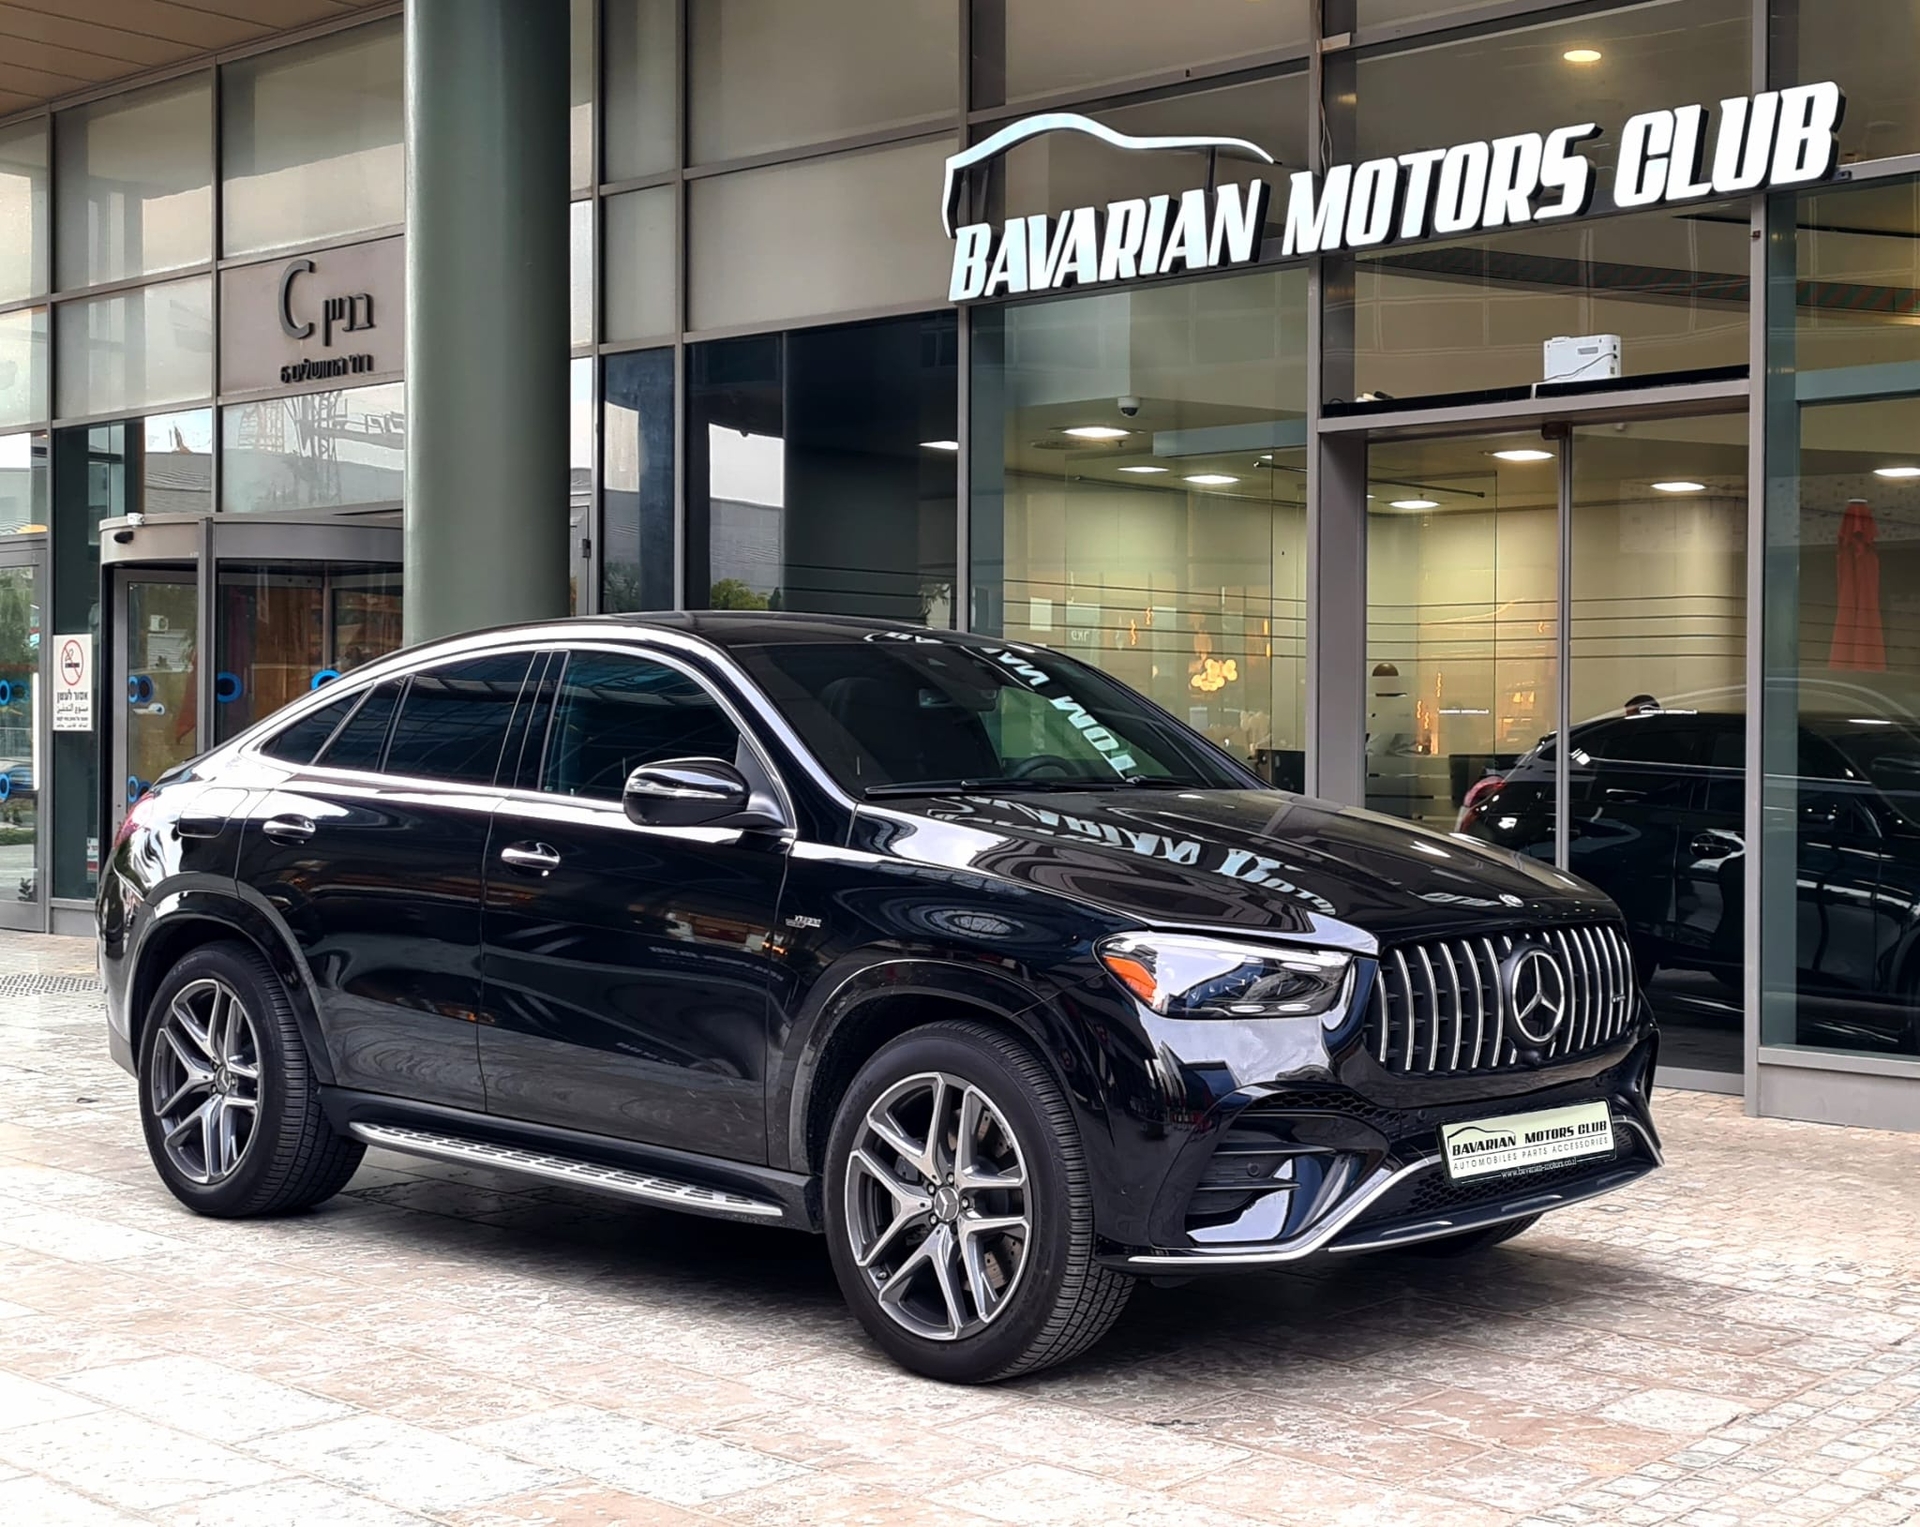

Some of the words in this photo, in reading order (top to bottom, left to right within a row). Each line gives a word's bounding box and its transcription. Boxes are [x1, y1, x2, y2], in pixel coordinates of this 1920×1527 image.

[948, 178, 1268, 301] BAVARIAN
[1281, 121, 1600, 256] MOTORS
[1613, 80, 1843, 208] CLUB
[278, 258, 316, 341] C
[322, 292, 376, 348] בנין
[1452, 1134, 1517, 1156] BAVARIAN
[1525, 1125, 1574, 1144] MOTORS
[1578, 1120, 1607, 1135] CLUB
[1453, 1152, 1518, 1171] AUTOMOBILES
[1522, 1146, 1548, 1158] PARTS
[1552, 1136, 1609, 1153] ACCESSORIES
